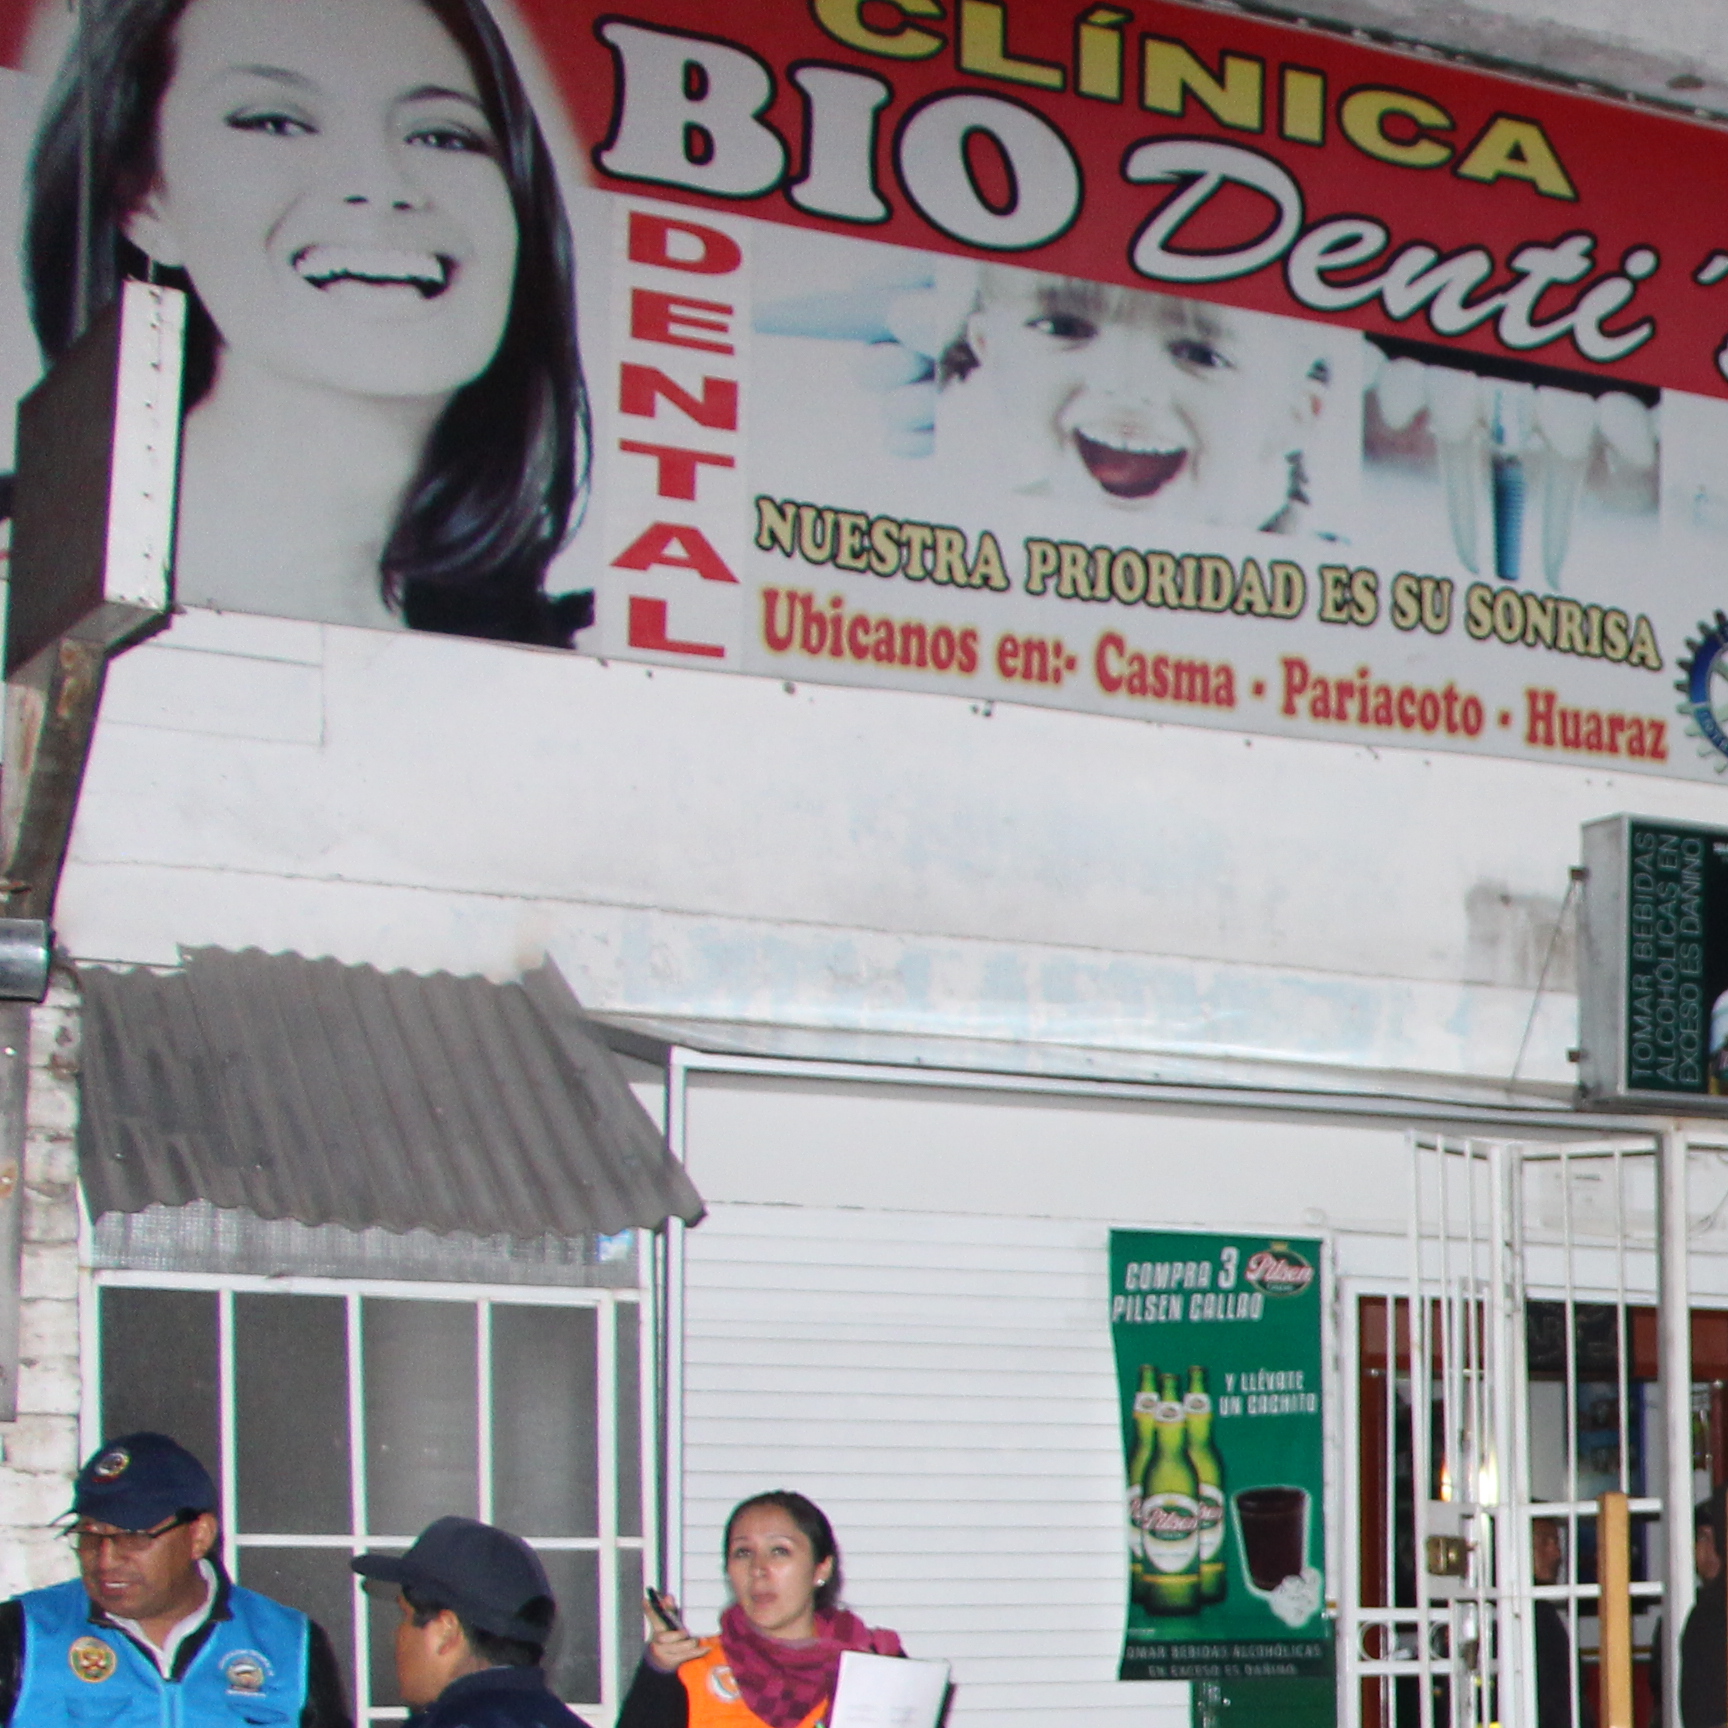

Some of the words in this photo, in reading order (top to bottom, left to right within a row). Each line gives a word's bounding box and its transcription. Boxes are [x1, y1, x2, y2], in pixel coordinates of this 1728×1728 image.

[594, 17, 1084, 252] BIO
[811, 0, 1578, 201] CLÍNICA
[611, 211, 743, 657] DENTAL
[756, 495, 1010, 591] NUESTRA
[1024, 537, 1305, 620] PRIORIDAD
[1319, 564, 1379, 626] ES
[1392, 572, 1454, 633] SU
[1466, 582, 1662, 671] SONRISA
[761, 586, 979, 675] Ubicanos
[1095, 630, 1237, 709] Casma
[1281, 656, 1484, 737] Pariacoto
[1525, 687, 1668, 762] Huaraz
[1633, 832, 1656, 961] BEBIDAS
[1657, 834, 1680, 872] EN
[1655, 881, 1681, 1083] ALCOHÓLICAS
[1680, 942, 1701, 975] ES
[1633, 974, 1655, 1078] TOMAR
[1679, 983, 1700, 1084] EXCESO
[1112, 1293, 1184, 1323] PILSEN
[1189, 1292, 1265, 1321] CALLAO
[1125, 1261, 1212, 1291] COMPRA
[1218, 1246, 1240, 1289] 3
[1245, 1251, 1315, 1282] Pilsen
[1220, 1395, 1242, 1416] UN
[1225, 1372, 1236, 1392] Y
[1241, 1367, 1304, 1392] LLÉVATE
